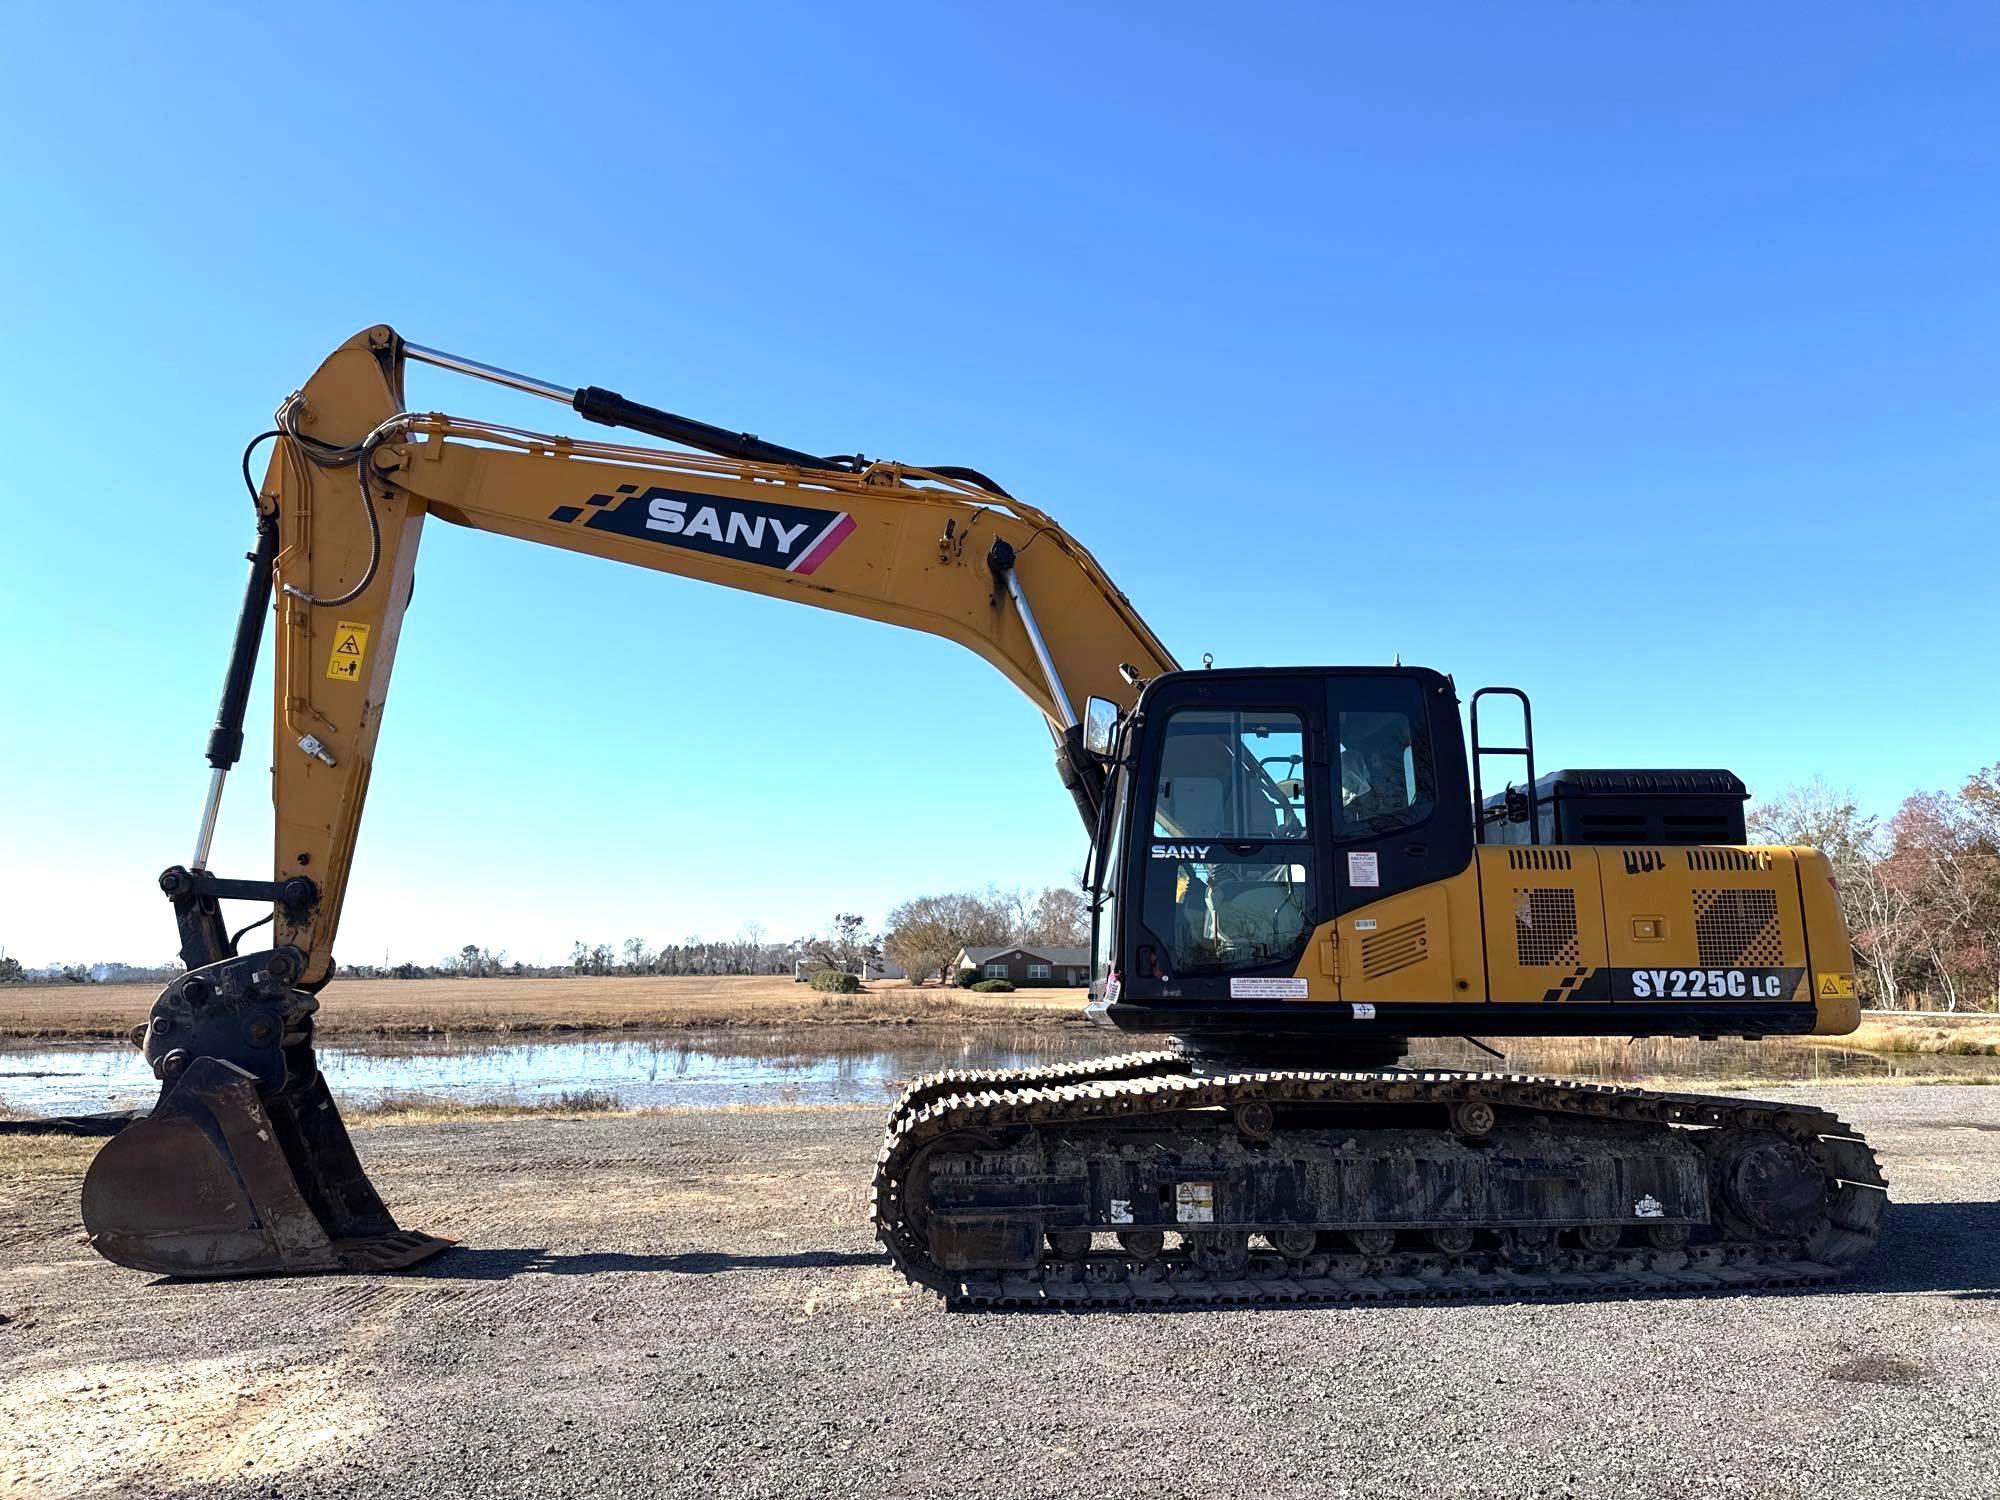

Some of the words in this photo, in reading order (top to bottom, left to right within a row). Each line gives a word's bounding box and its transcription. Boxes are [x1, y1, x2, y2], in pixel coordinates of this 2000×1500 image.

[645, 497, 809, 554] SANY
[1151, 844, 1211, 859] SANY
[1631, 970, 1746, 997] SY225C
[1751, 975, 1781, 997] LC
